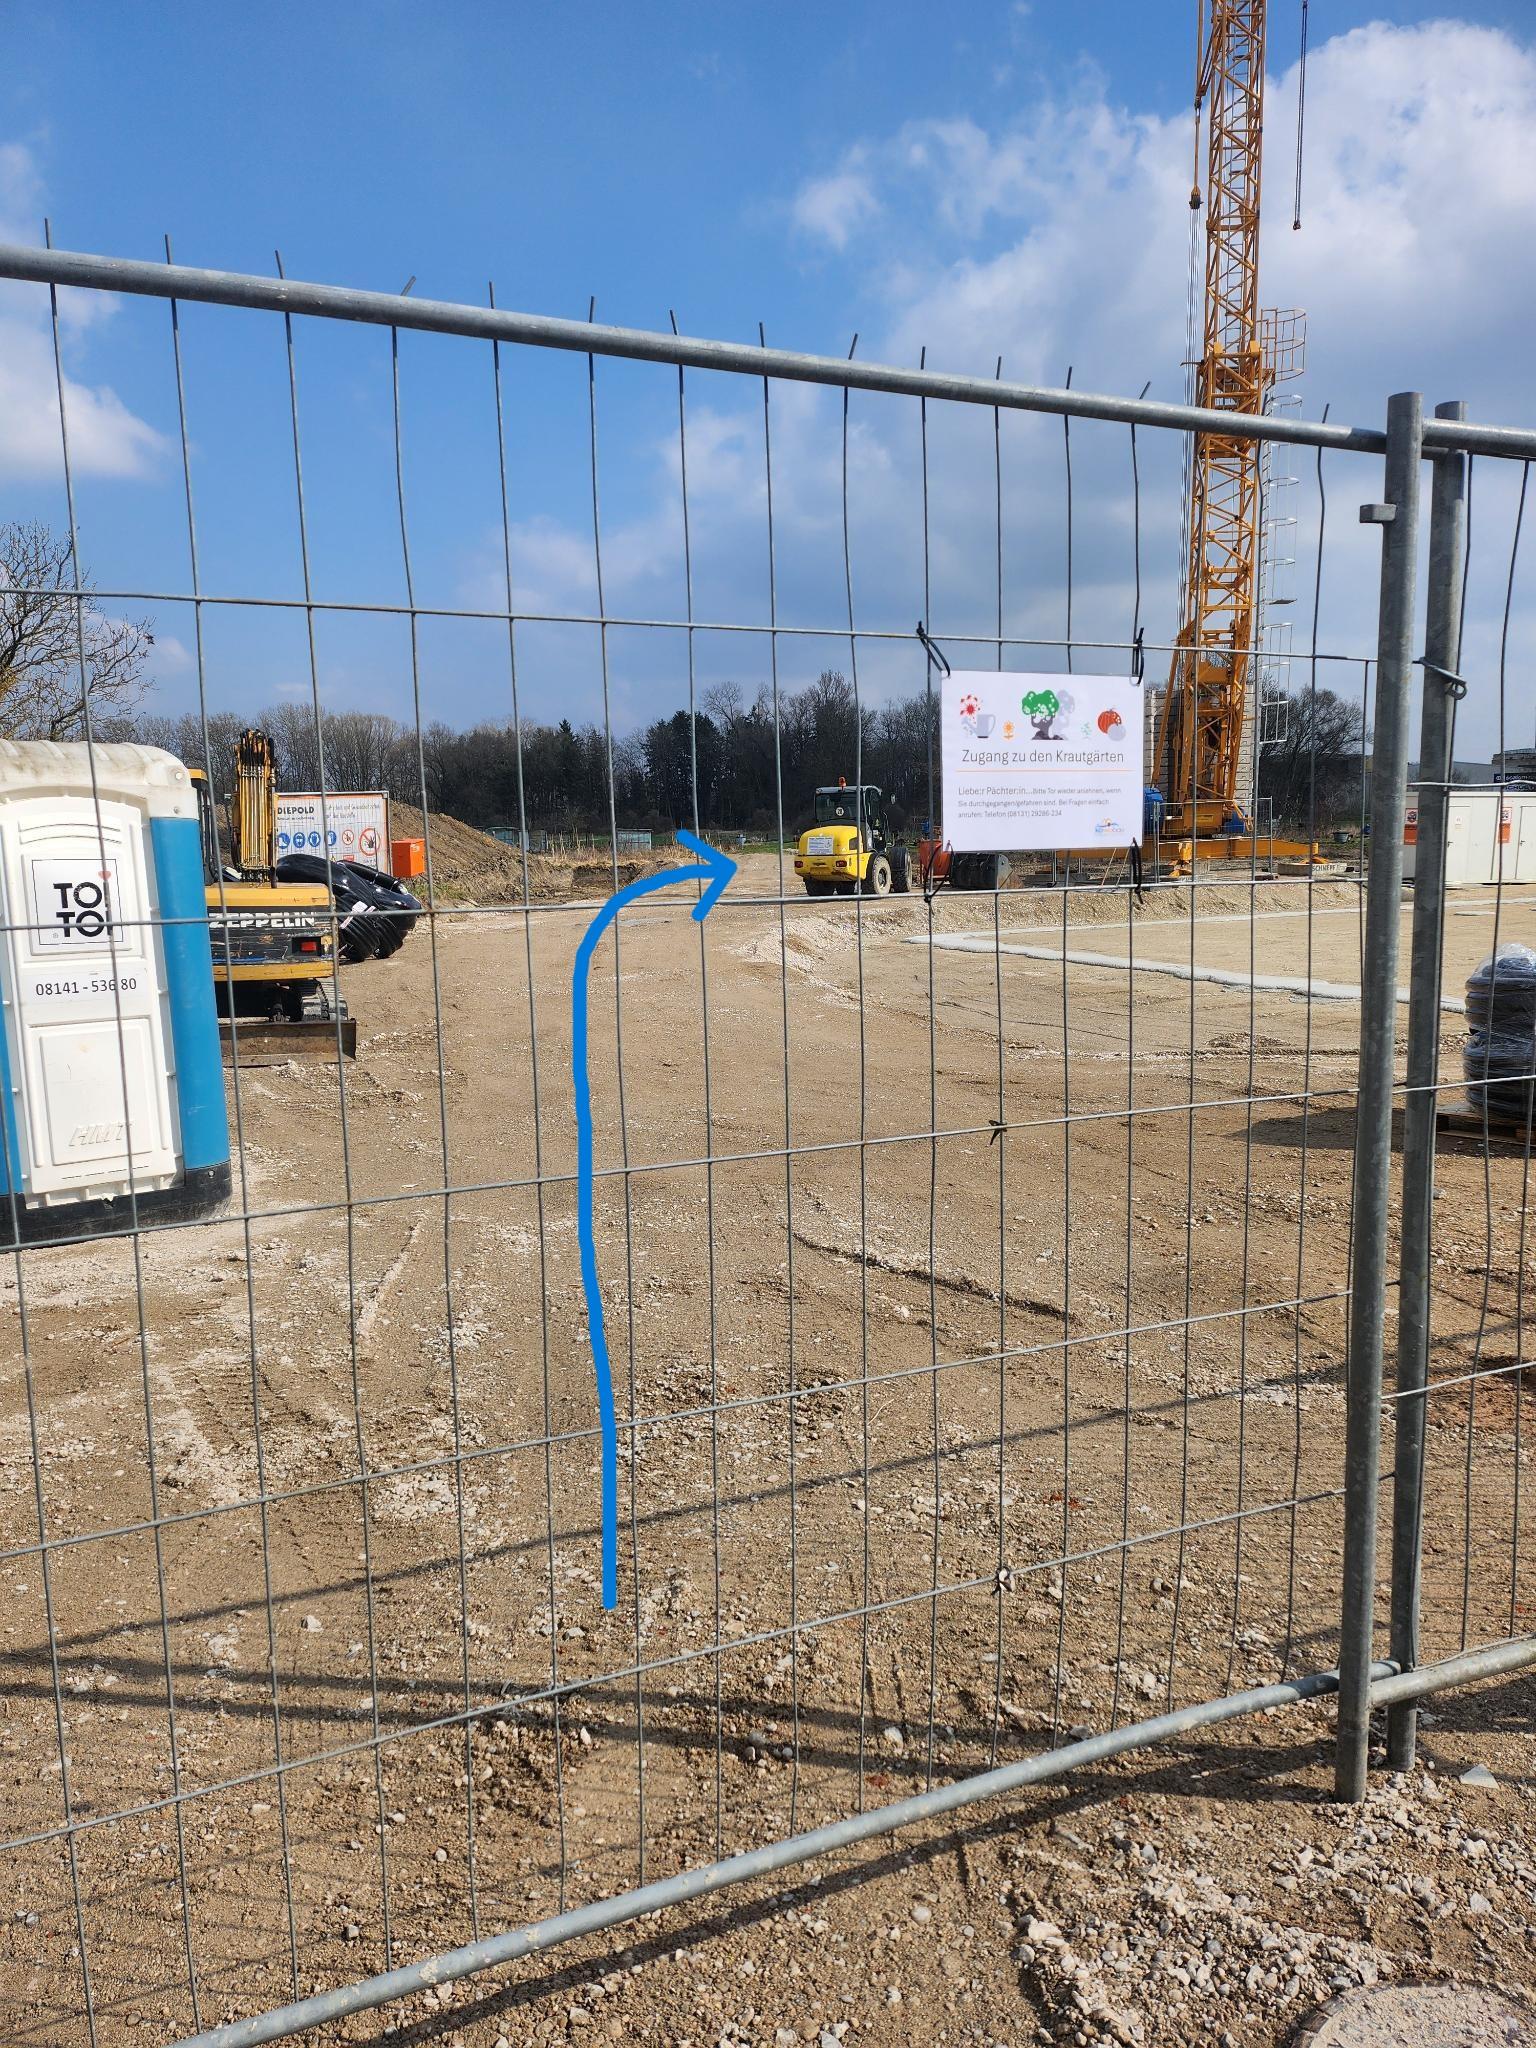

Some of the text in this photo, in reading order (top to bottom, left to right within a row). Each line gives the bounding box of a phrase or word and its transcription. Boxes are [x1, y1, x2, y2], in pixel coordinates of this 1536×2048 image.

[961, 749, 1124, 765] Zugang zu den Krautgärten
[1069, 799, 1087, 807] Fragen
[277, 806, 315, 815] DIEPOLD
[984, 810, 1007, 818] Telefon
[208, 911, 315, 928] ZEPPELIN
[35, 981, 80, 996] 08141
